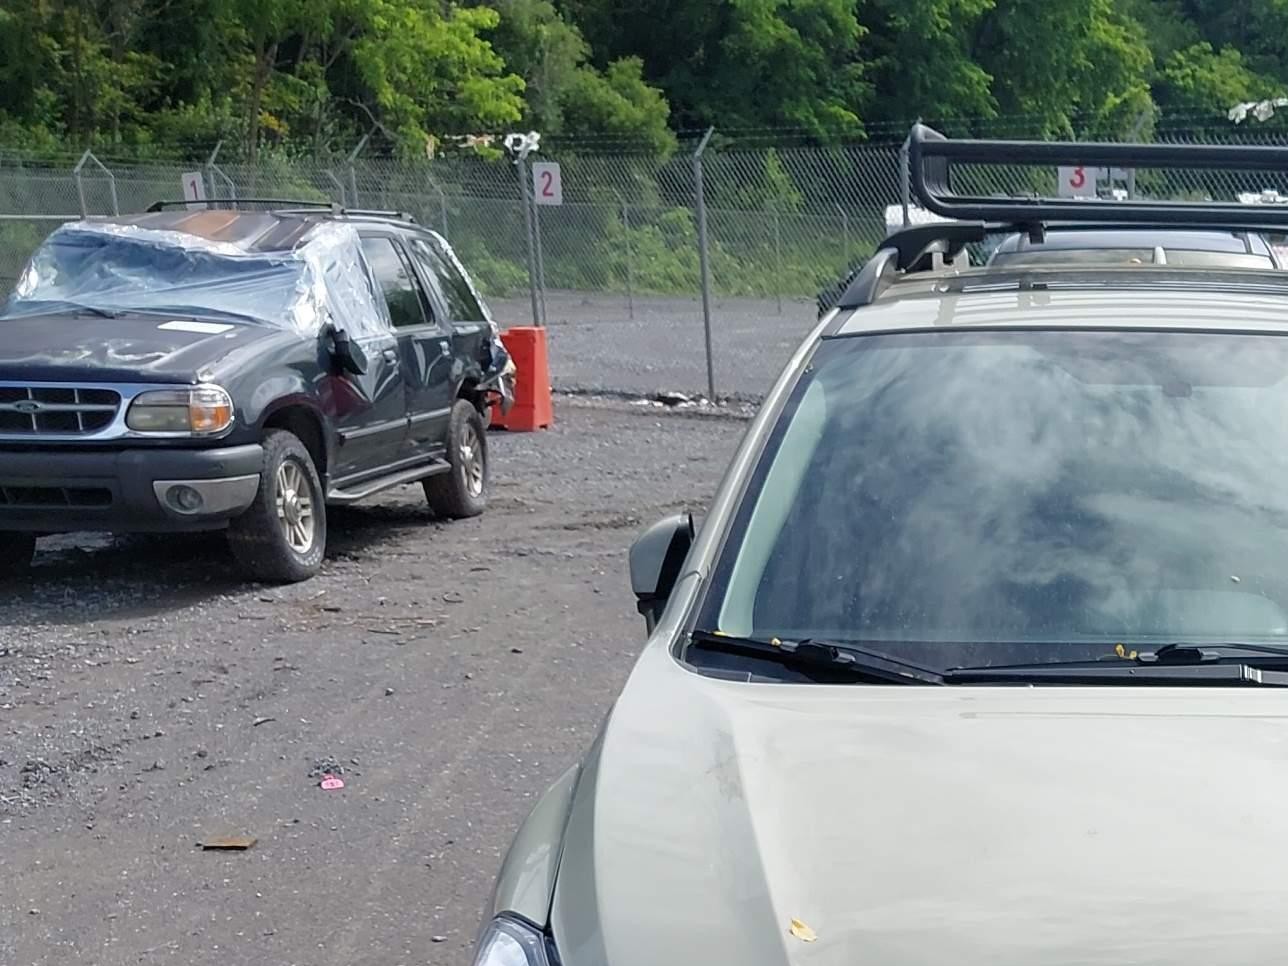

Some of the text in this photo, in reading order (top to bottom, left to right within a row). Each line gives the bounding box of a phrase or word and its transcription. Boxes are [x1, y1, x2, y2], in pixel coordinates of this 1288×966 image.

[540, 170, 555, 197] 2
[1069, 163, 1085, 189] 3
[190, 179, 199, 201] 1
